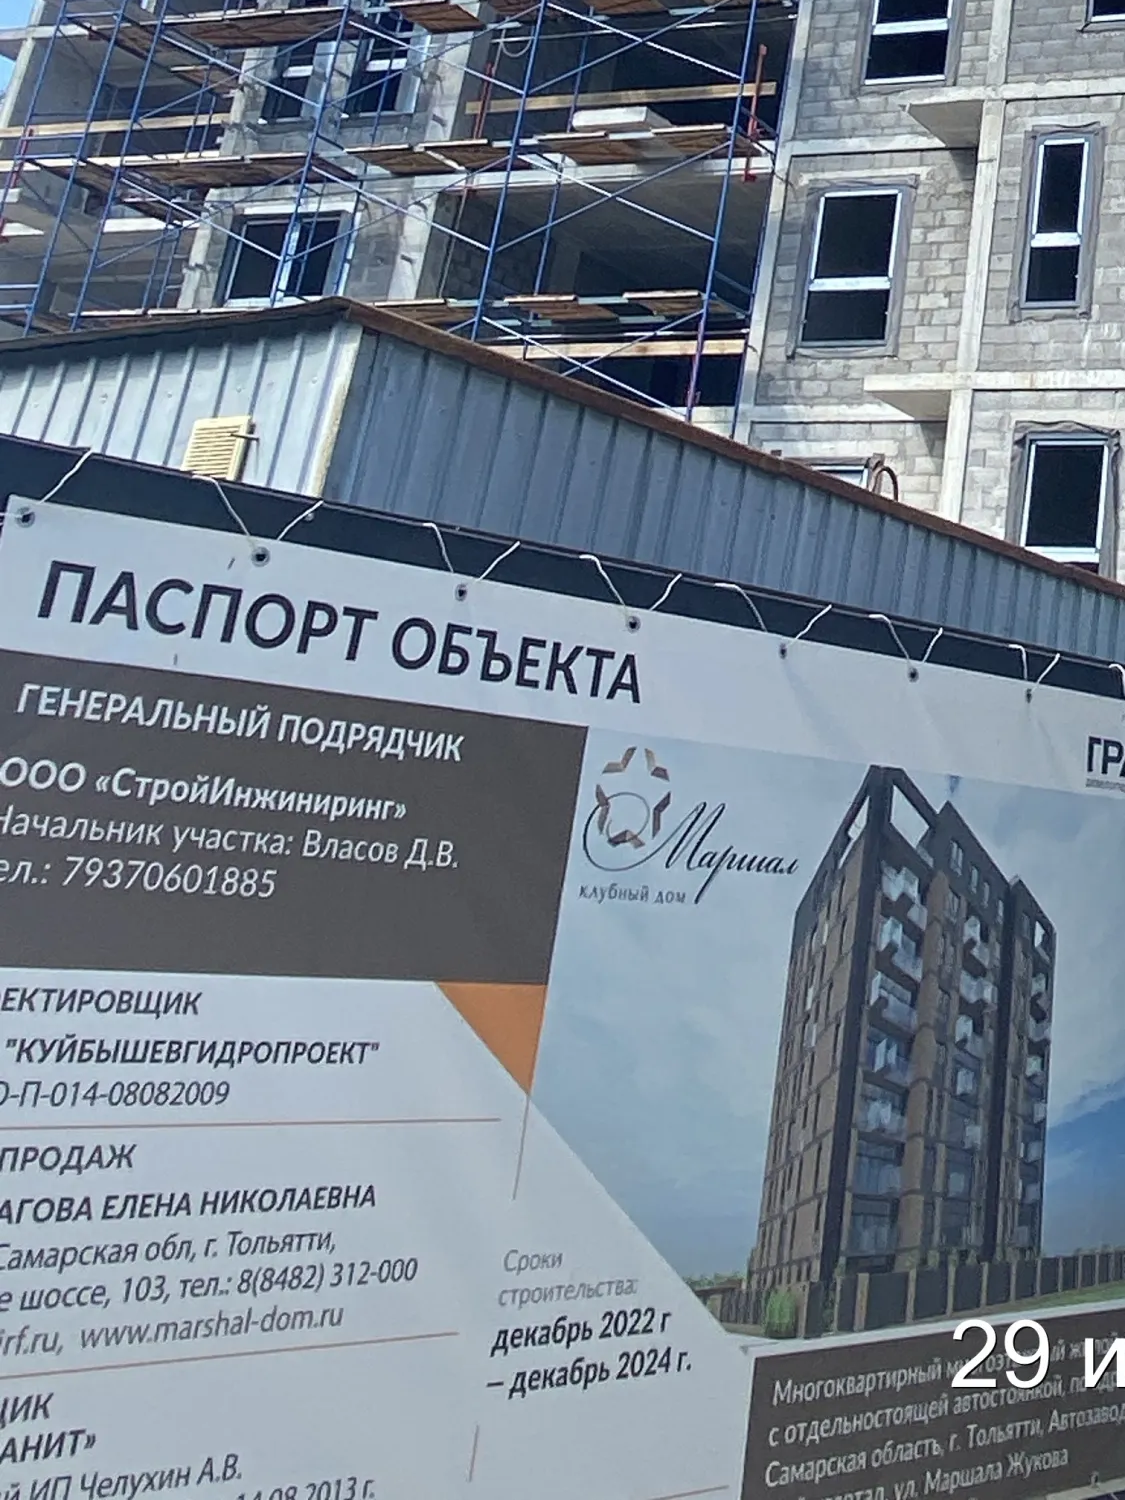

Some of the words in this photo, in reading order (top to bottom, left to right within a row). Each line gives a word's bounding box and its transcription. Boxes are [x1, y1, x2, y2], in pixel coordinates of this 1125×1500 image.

[37, 560, 379, 662] ПАСПОРТ
[392, 617, 641, 704] ОБЪЕКТА
[16, 683, 271, 739] ГЕНЕРАЛЬНЫЙ
[278, 714, 465, 762] ПОДРЯДЧИК
[0, 756, 87, 792] ООО
[95, 767, 407, 821] «СтройИнжиниринг»
[171, 825, 294, 855] участка:
[302, 829, 399, 864] Власов
[403, 838, 459, 871] Д.В.
[583, 791, 799, 905] Маршал
[62, 856, 278, 898] 79370601885
[579, 882, 649, 905] клубный
[655, 891, 687, 904] дом
[0, 987, 202, 1019] ЕКТИРОВЩИК
[6, 1033, 379, 1068] "КУЙБЫШЕВГИДРОПРОЕКТ"
[0, 1144, 137, 1175] ПРОДАЖ
[101, 1192, 191, 1220] ЕЛЕНА
[200, 1184, 376, 1215] НИКОЛАЕВНА
[145, 1233, 196, 1263] обл,
[204, 1238, 218, 1258] г.
[227, 1231, 336, 1257] Тольятти,
[503, 1249, 563, 1276] Сроки
[19, 1285, 110, 1311] шоссе,
[123, 1275, 170, 1304] 103,
[179, 1275, 233, 1298] тел.:
[237, 1263, 325, 1297] 8(8482)
[329, 1258, 419, 1287] 312-000
[498, 1278, 638, 1310] строительства:
[80, 1305, 344, 1348] www.marshal-dom.ru
[489, 1315, 593, 1358] декабрь
[599, 1307, 656, 1339] 2022
[660, 1312, 672, 1332] г
[508, 1357, 610, 1400] декабрь
[616, 1346, 672, 1380] 2024
[676, 1351, 692, 1372] г.
[772, 1356, 942, 1406] Многоквартирный
[768, 1427, 779, 1447] с
[784, 1393, 949, 1446] отдельностоящей
[765, 1451, 867, 1487] Самарская
[871, 1437, 945, 1469] область,
[949, 1433, 961, 1453] г.
[967, 1418, 1043, 1448] Тольятти,
[923, 1461, 1003, 1495] Маршала
[1006, 1448, 1069, 1479] Жукова
[29, 1476, 73, 1500] ИП
[80, 1466, 191, 1500] Челухин
[196, 1453, 243, 1486] А.В.
